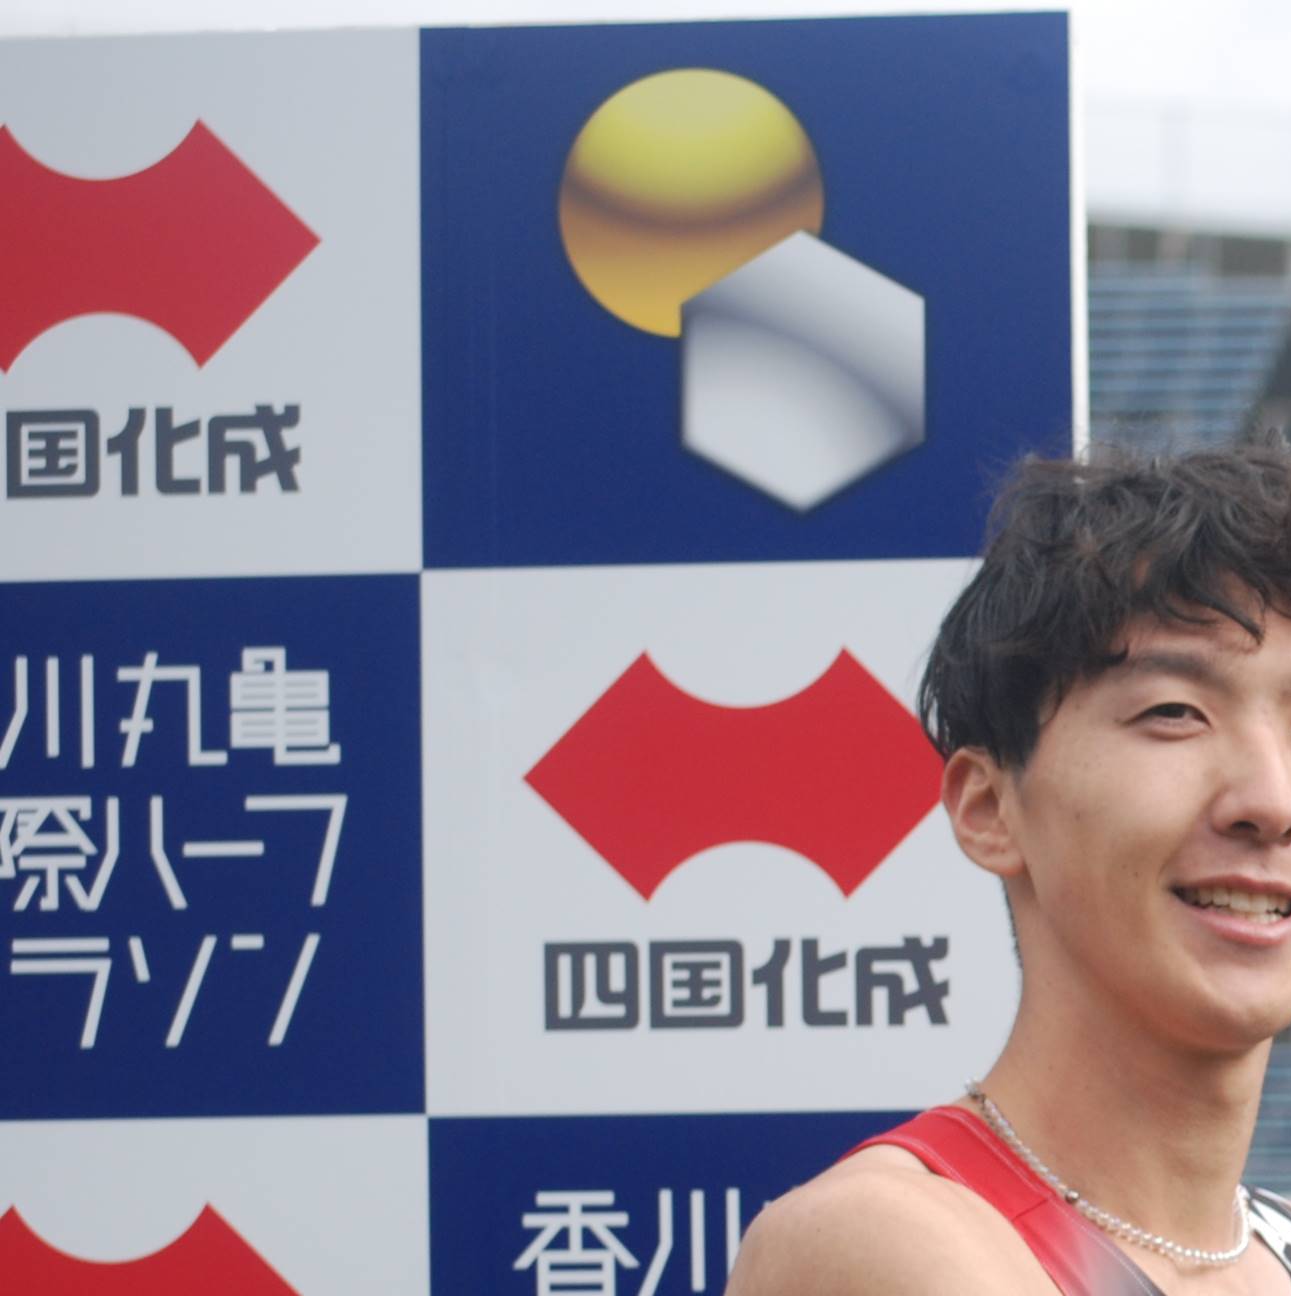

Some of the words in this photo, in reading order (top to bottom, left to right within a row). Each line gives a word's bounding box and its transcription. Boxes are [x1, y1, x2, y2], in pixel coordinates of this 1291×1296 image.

[6, 405, 301, 499] 国化成
[10, 933, 321, 1051] ラソン
[544, 936, 950, 1033] 四国化成
